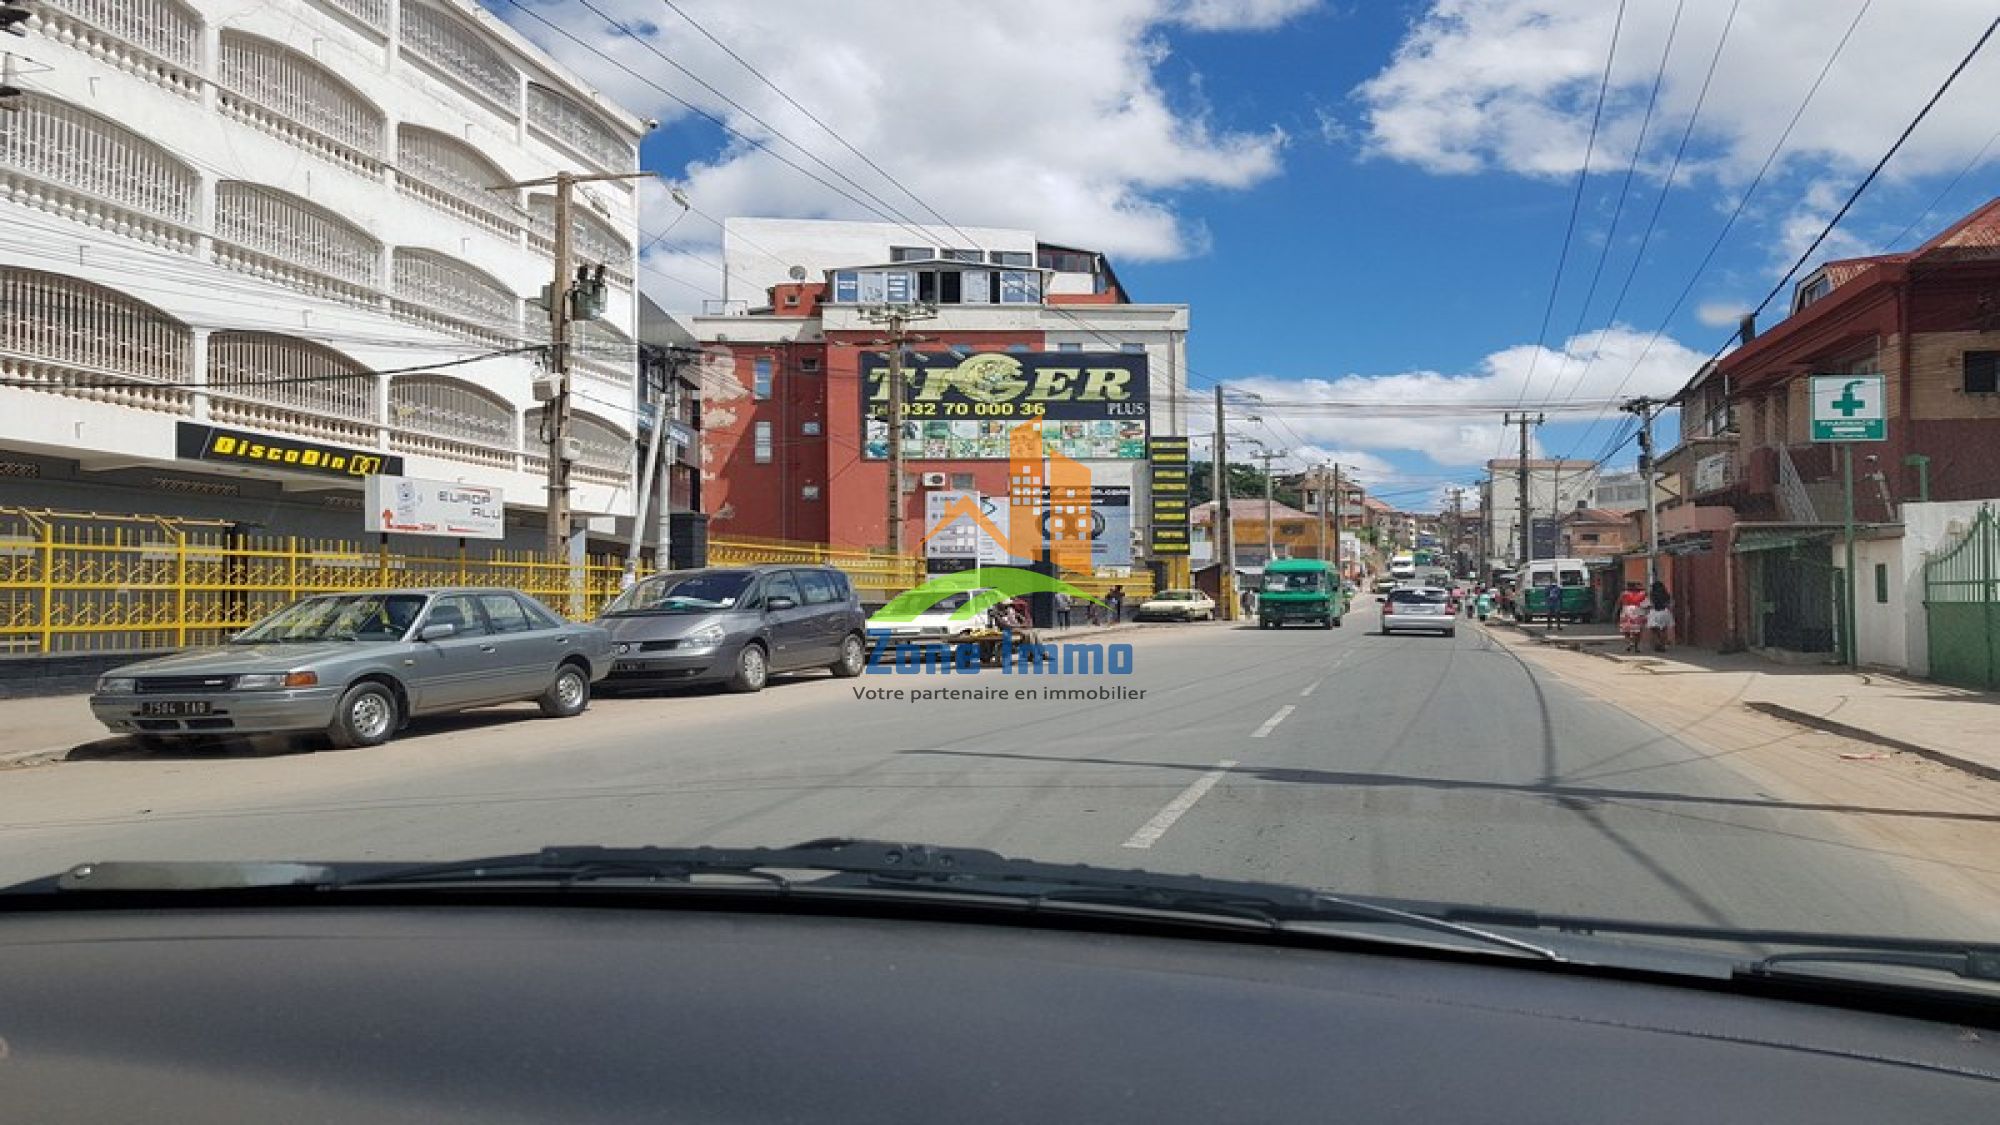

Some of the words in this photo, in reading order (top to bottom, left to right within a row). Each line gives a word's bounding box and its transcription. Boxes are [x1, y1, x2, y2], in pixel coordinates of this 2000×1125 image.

[869, 353, 1131, 402] TIGER
[899, 403, 936, 416] 032
[942, 403, 968, 416] 70
[974, 403, 1013, 416] 000
[1019, 403, 1046, 416] 36
[1107, 402, 1146, 416] PLUS
